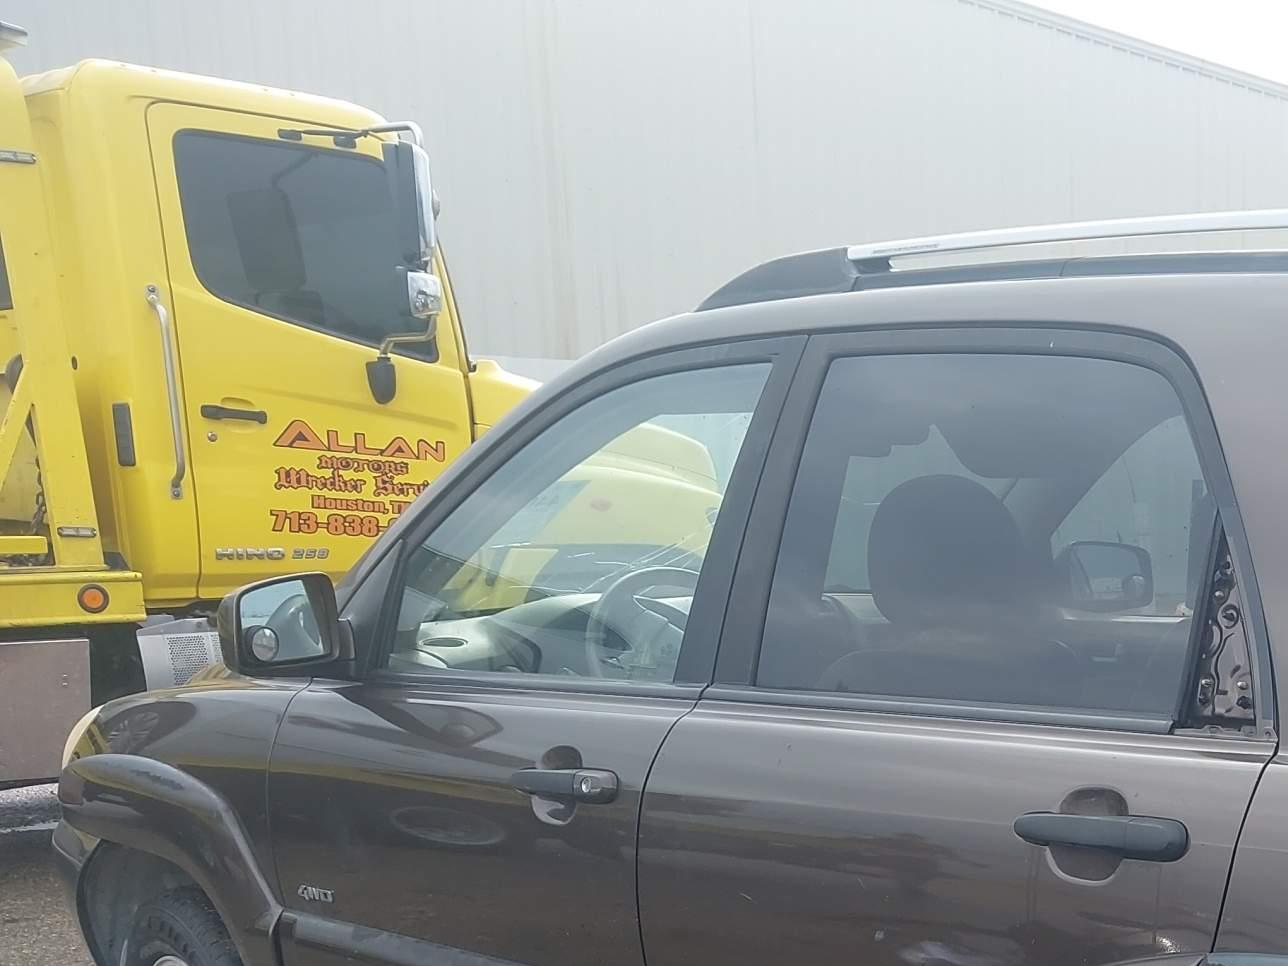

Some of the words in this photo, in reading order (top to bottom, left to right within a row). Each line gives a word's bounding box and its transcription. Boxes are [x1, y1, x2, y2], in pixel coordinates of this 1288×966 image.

[273, 420, 445, 462] ALLAN
[317, 455, 409, 475] MOTORS
[274, 467, 366, 493] Wrecker
[373, 473, 429, 497] Serv
[311, 495, 389, 514] Houston,
[270, 510, 398, 537] 713-838-
[216, 547, 285, 561] HINO
